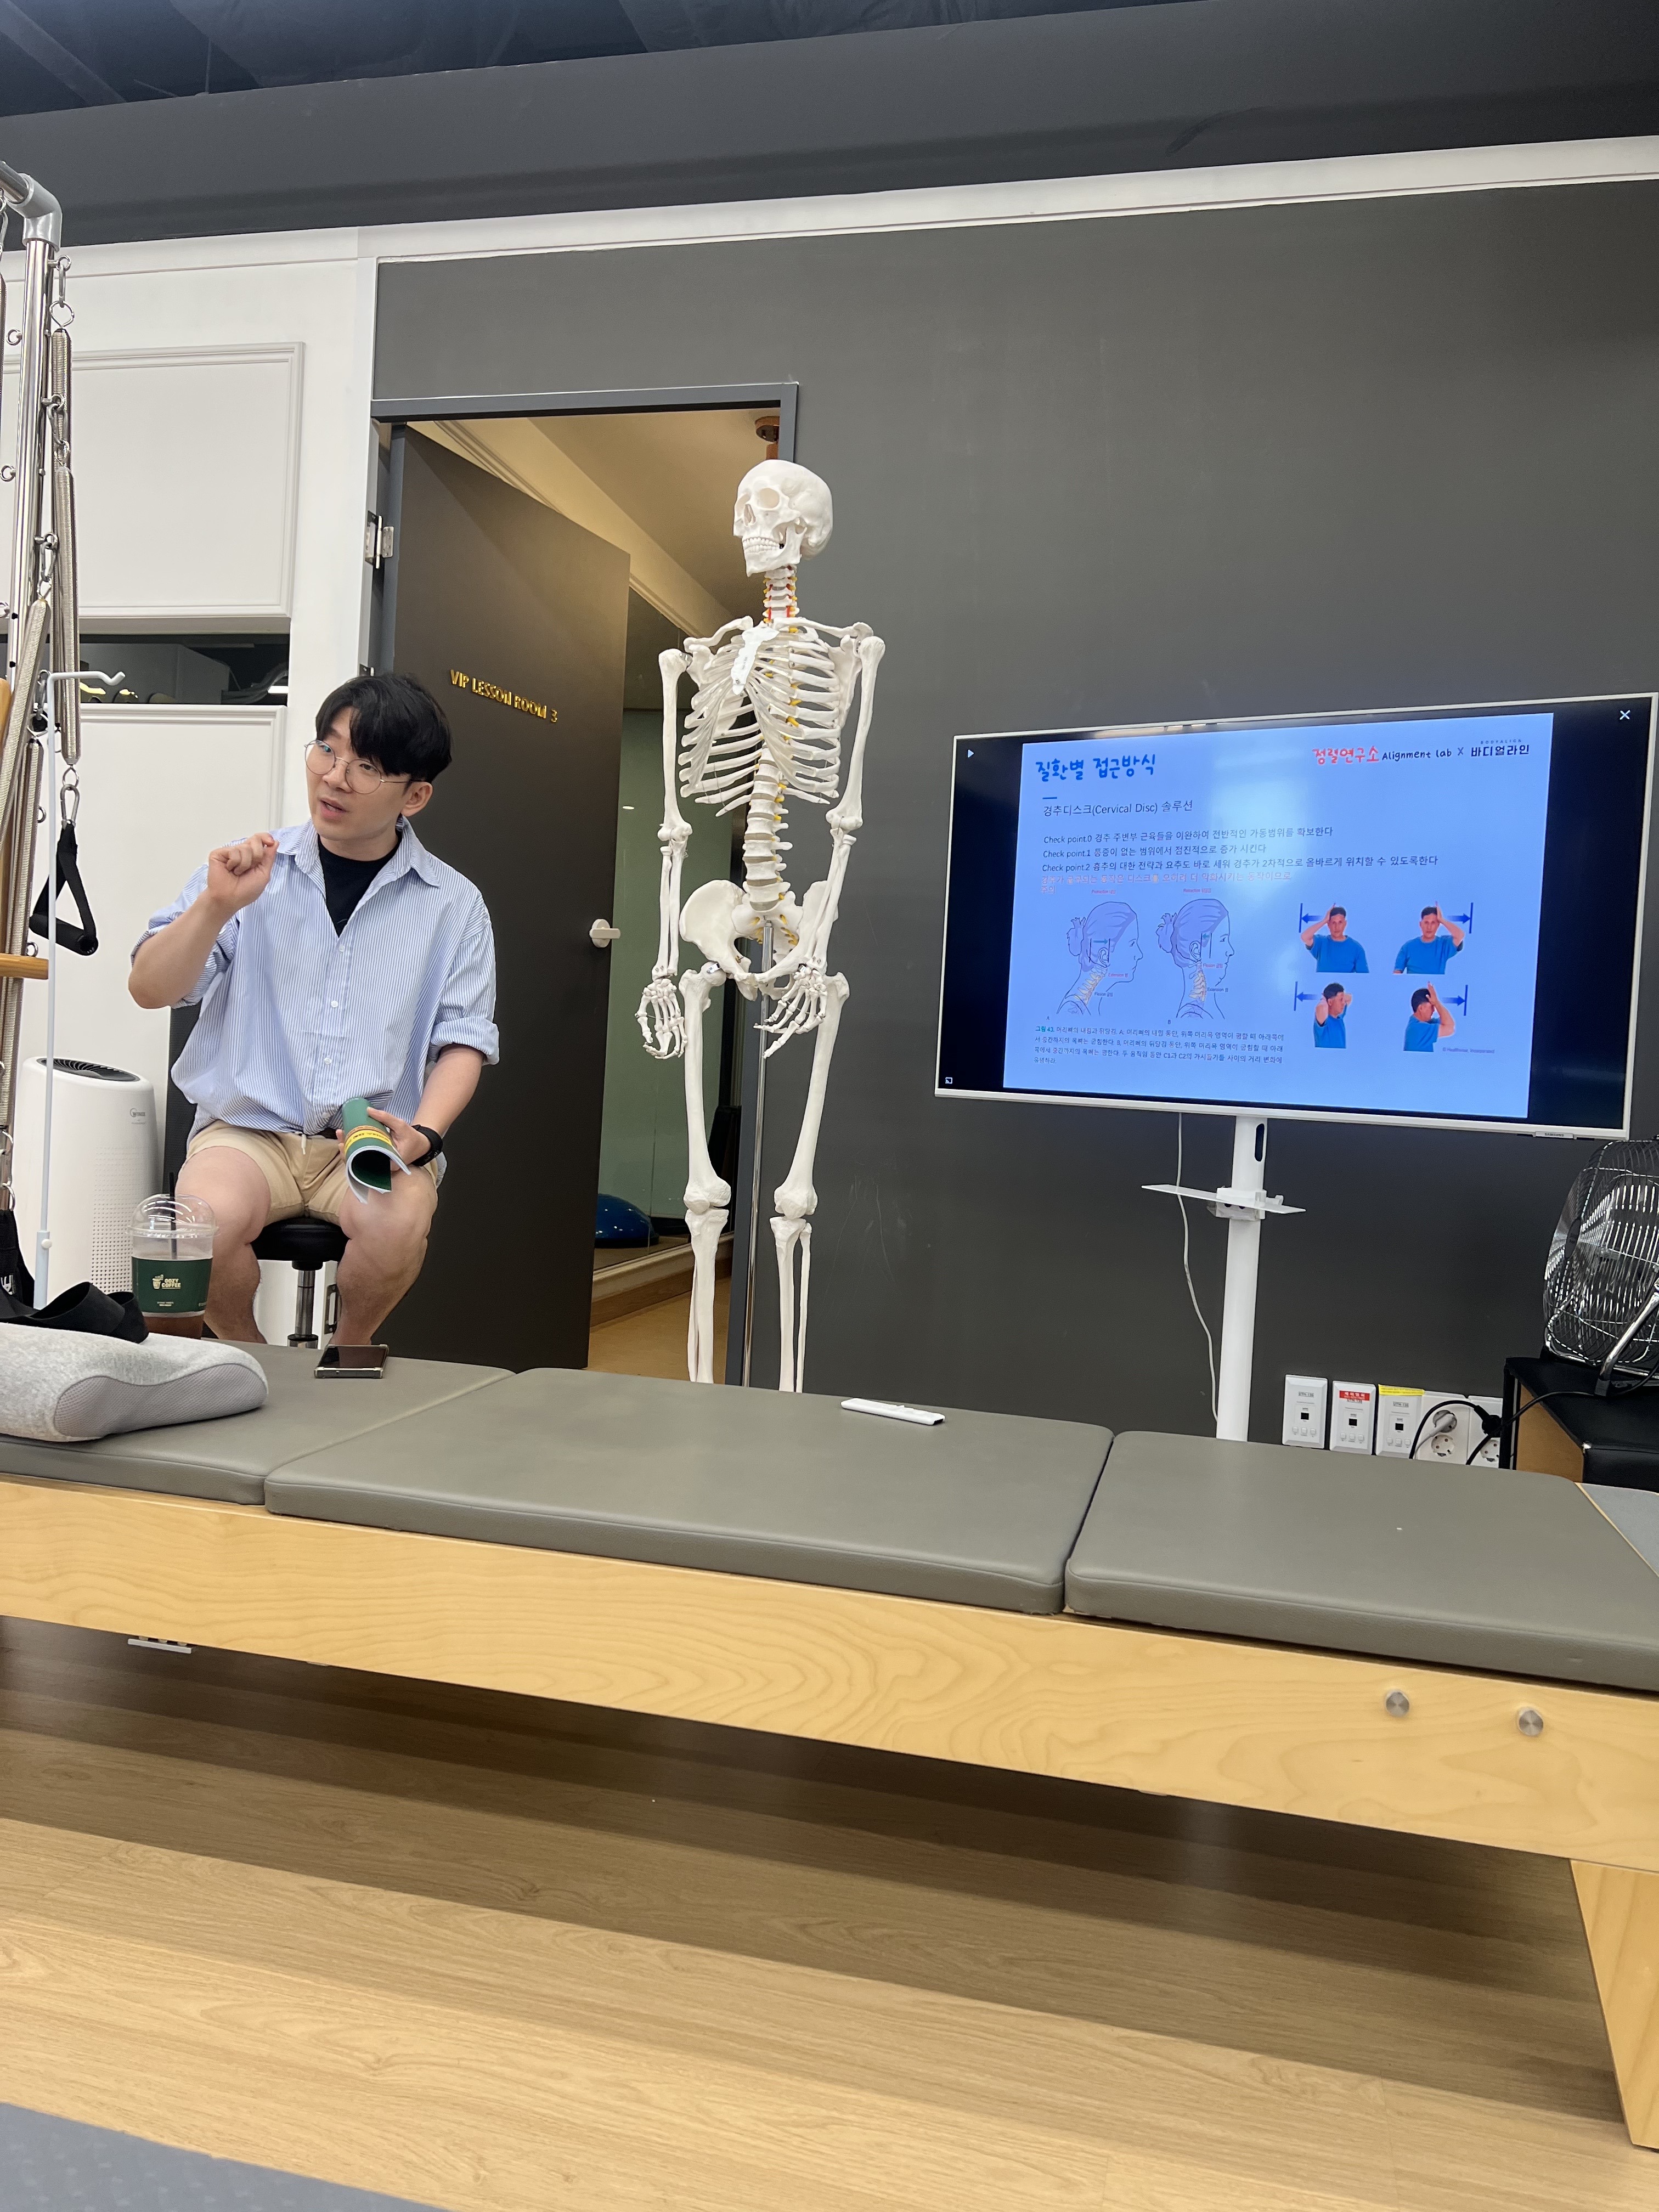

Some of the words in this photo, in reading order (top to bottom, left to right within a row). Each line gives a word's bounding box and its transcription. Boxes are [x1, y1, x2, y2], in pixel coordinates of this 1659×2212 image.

[450, 669, 470, 689] VIP
[472, 678, 512, 706] LESSON
[514, 695, 547, 719] ROOM
[551, 709, 558, 723] 3
[1312, 746, 1379, 765] 정렬연구소
[1381, 750, 1431, 761] Alignment
[1436, 748, 1452, 758] lab
[1471, 744, 1530, 757] 바디얼라인
[1036, 758, 1084, 782] 질환별
[1093, 754, 1155, 779] 접근방식
[1043, 803, 1132, 817] 경추디스크(Cervical
[1136, 803, 1158, 815] Disc)
[1161, 800, 1193, 812] 솔루션
[1068, 834, 1092, 844] point.0
[1095, 834, 1110, 843] 경추
[1114, 833, 1137, 842] 주변부
[1141, 831, 1173, 841] 근육들을
[1176, 830, 1209, 840] 이완하여
[1213, 829, 1246, 839] 전반적인
[1250, 828, 1294, 838] 가동범위를
[1297, 827, 1333, 837] 확보한다
[1066, 850, 1091, 859] point.1
[1094, 848, 1118, 857] 통증이
[1121, 848, 1137, 856] 없는
[1140, 846, 1172, 856] 범위에서
[1175, 845, 1217, 855] 점진적으로
[1220, 845, 1237, 854] 증가
[1240, 844, 1266, 854] 시킨다
[1066, 864, 1090, 872] point.2
[1093, 862, 1116, 871] 흉추의
[1120, 862, 1136, 871] 대한
[1138, 861, 1163, 870] 전략과
[1165, 861, 1190, 870] 요추도
[1194, 860, 1210, 869] 바로
[1214, 860, 1231, 869] 세워
[1234, 859, 1260, 868] 경추가
[1262, 858, 1303, 867] 2차적으로
[1306, 857, 1342, 867] 올바르게
[1346, 856, 1374, 867] 위치할
[1377, 856, 1386, 866] 수
[1390, 855, 1438, 866] 있도록한다
[1163, 873, 1187, 882] 오히려
[1190, 873, 1198, 882] 더
[1201, 872, 1244, 882] 악화시키는
[1041, 885, 1056, 894] 주의
